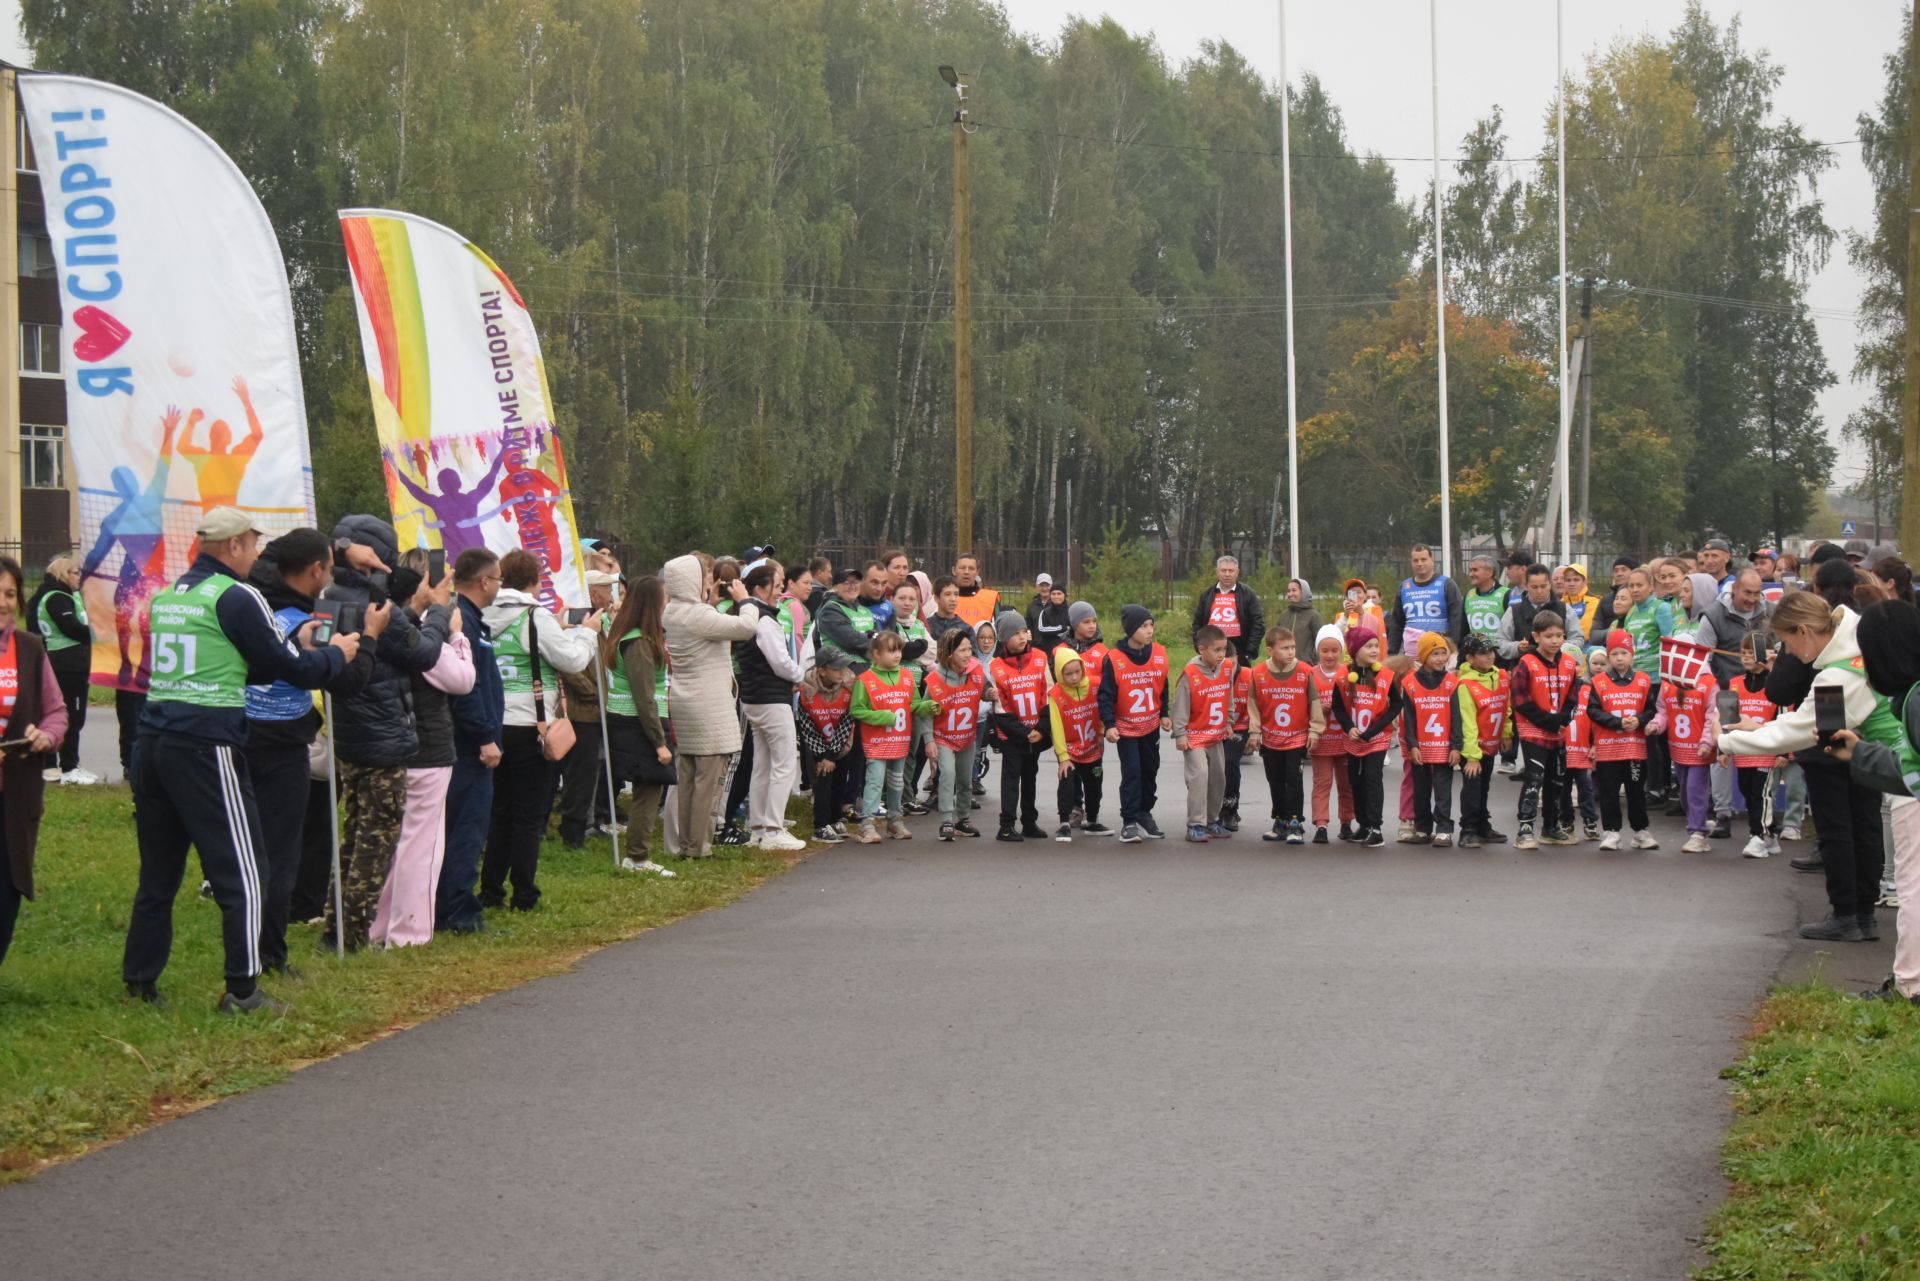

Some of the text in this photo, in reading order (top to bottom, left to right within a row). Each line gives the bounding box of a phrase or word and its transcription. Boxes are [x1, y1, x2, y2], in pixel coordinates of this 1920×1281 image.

[51, 107, 135, 398] Я СПОРТ!
[479, 289, 514, 388] СПОРТА!
[497, 389, 529, 466] РИТМЕ
[512, 470, 532, 486] В
[157, 614, 186, 625] РАЙОН
[1210, 607, 1237, 623] 49
[1403, 600, 1441, 619] 216
[1131, 677, 1153, 685] РАЙОН
[1013, 692, 1038, 717] 11
[1128, 687, 1154, 714] 21
[948, 707, 973, 731] 12
[1208, 702, 1224, 726] 5
[1274, 703, 1291, 727] 6
[1424, 713, 1445, 737] 4
[1490, 712, 1503, 737] 7
[1073, 720, 1096, 746] 14
[1674, 714, 1691, 739] 8
